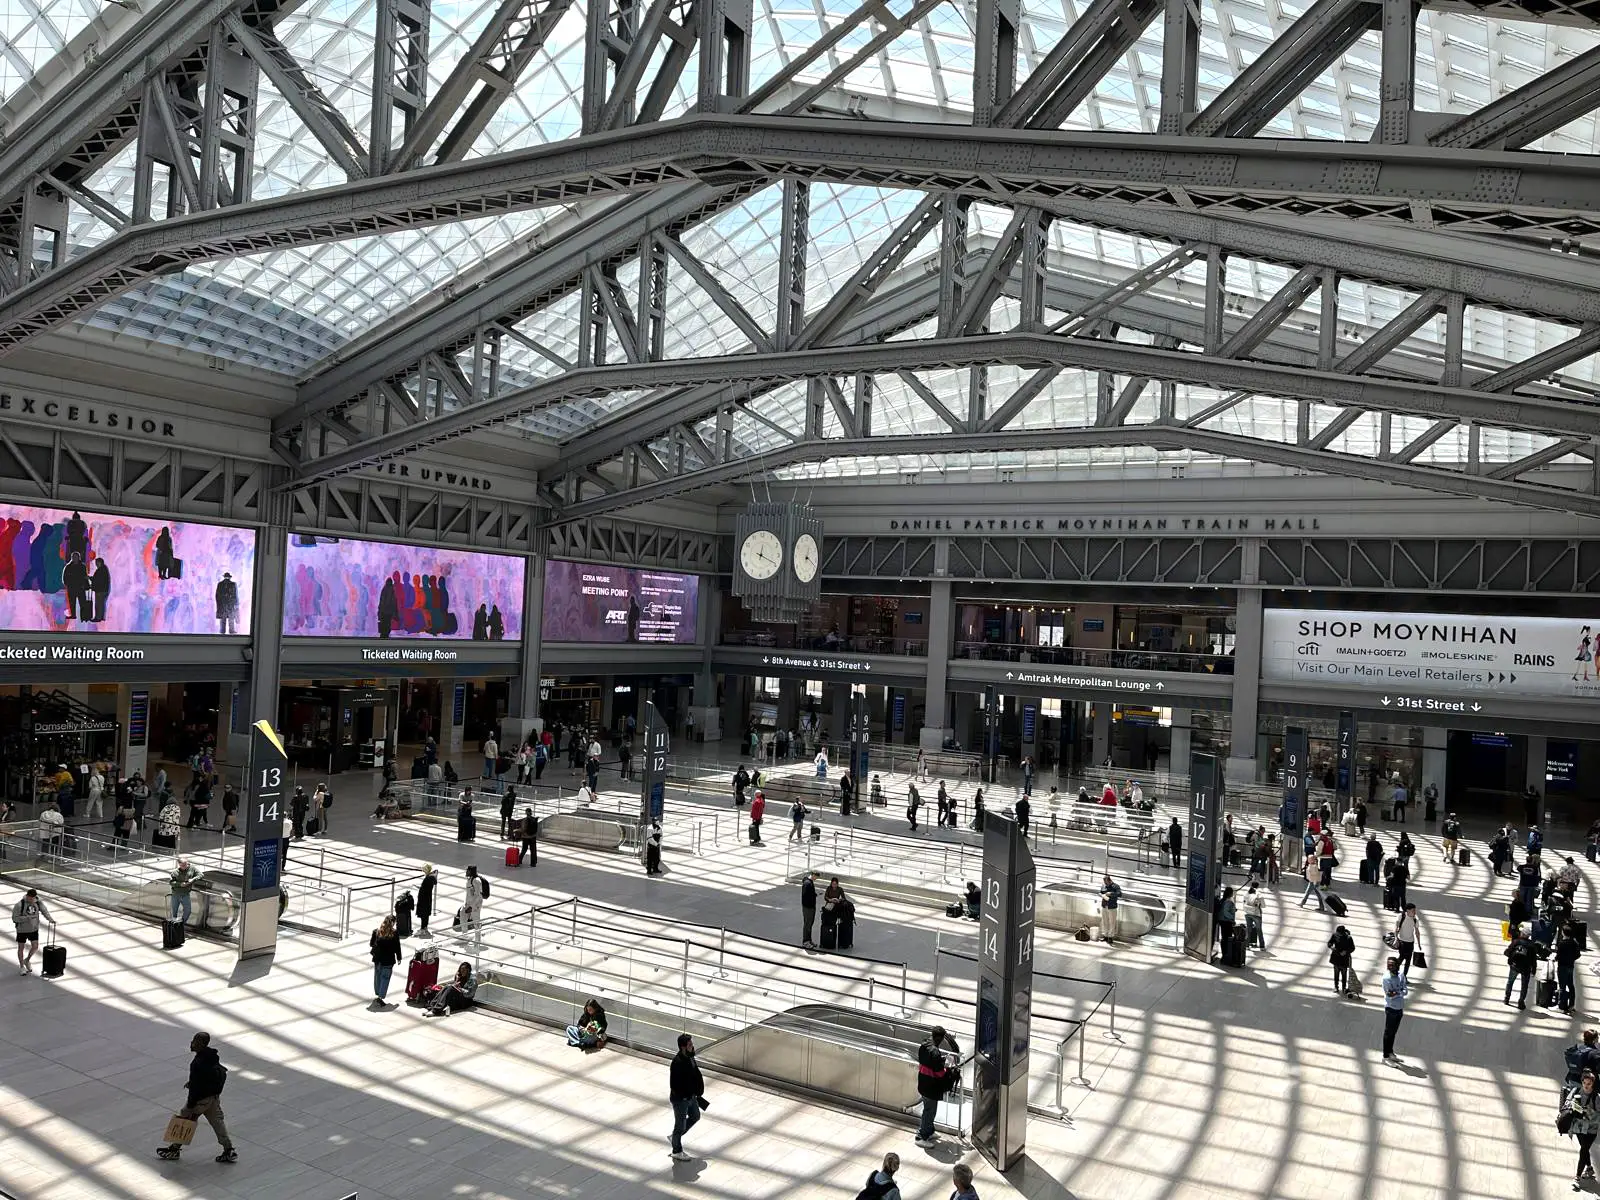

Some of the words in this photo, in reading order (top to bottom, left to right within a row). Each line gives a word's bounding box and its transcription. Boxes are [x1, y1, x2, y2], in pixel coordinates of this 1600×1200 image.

[0, 394, 175, 437] EXCELSIOR
[421, 468, 492, 490] UPWARD
[890, 519, 952, 530] DANIEL
[964, 519, 1045, 530] PATRICK
[1058, 518, 1167, 530] MOYNIHAN
[1182, 518, 1249, 530] TRAIN
[1265, 518, 1320, 530] HALL
[582, 574, 595, 582] EZRA
[582, 586, 609, 596] MEETING
[610, 588, 628, 597] POINT
[605, 610, 628, 620] ART
[1298, 620, 1362, 638] SHOP
[1373, 623, 1517, 645] MOYNIHAN
[51, 646, 103, 661] Waiting
[107, 647, 144, 659] Room
[362, 649, 399, 659] Ticketed
[401, 649, 433, 661] Waiting
[434, 649, 457, 659] Room
[1297, 642, 1321, 656] citi
[771, 656, 783, 665] 8th
[784, 657, 811, 667] Avenue
[820, 659, 836, 668] 31st
[837, 660, 860, 670] Street
[1429, 652, 1494, 661] MOLESKINE
[1513, 653, 1555, 667] RAINS
[1297, 662, 1323, 673] Visit
[1327, 663, 1350, 674] Our
[1354, 665, 1383, 676] Main
[1388, 666, 1420, 678] Level
[1425, 668, 1482, 682] Retailers
[1018, 673, 1051, 683] Amtrak
[1053, 675, 1112, 687] Metropolitan
[1115, 679, 1151, 692] Lounge
[1397, 697, 1422, 708] 31st
[1426, 698, 1465, 711] Street
[863, 714, 869, 726] 9
[655, 733, 665, 747] 11
[862, 732, 869, 743] 10
[1342, 732, 1348, 742] 7
[1289, 754, 1296, 767] 9
[1341, 749, 1347, 759] 8
[653, 757, 664, 771] 12
[261, 767, 281, 788] 13
[1287, 776, 1297, 788] 10
[1194, 792, 1206, 811] 11
[257, 802, 279, 823] 14
[1193, 822, 1206, 841] 12
[985, 877, 1000, 909] 13
[1020, 882, 1033, 914] 13
[984, 927, 998, 962] 14
[1018, 933, 1031, 966] 14
